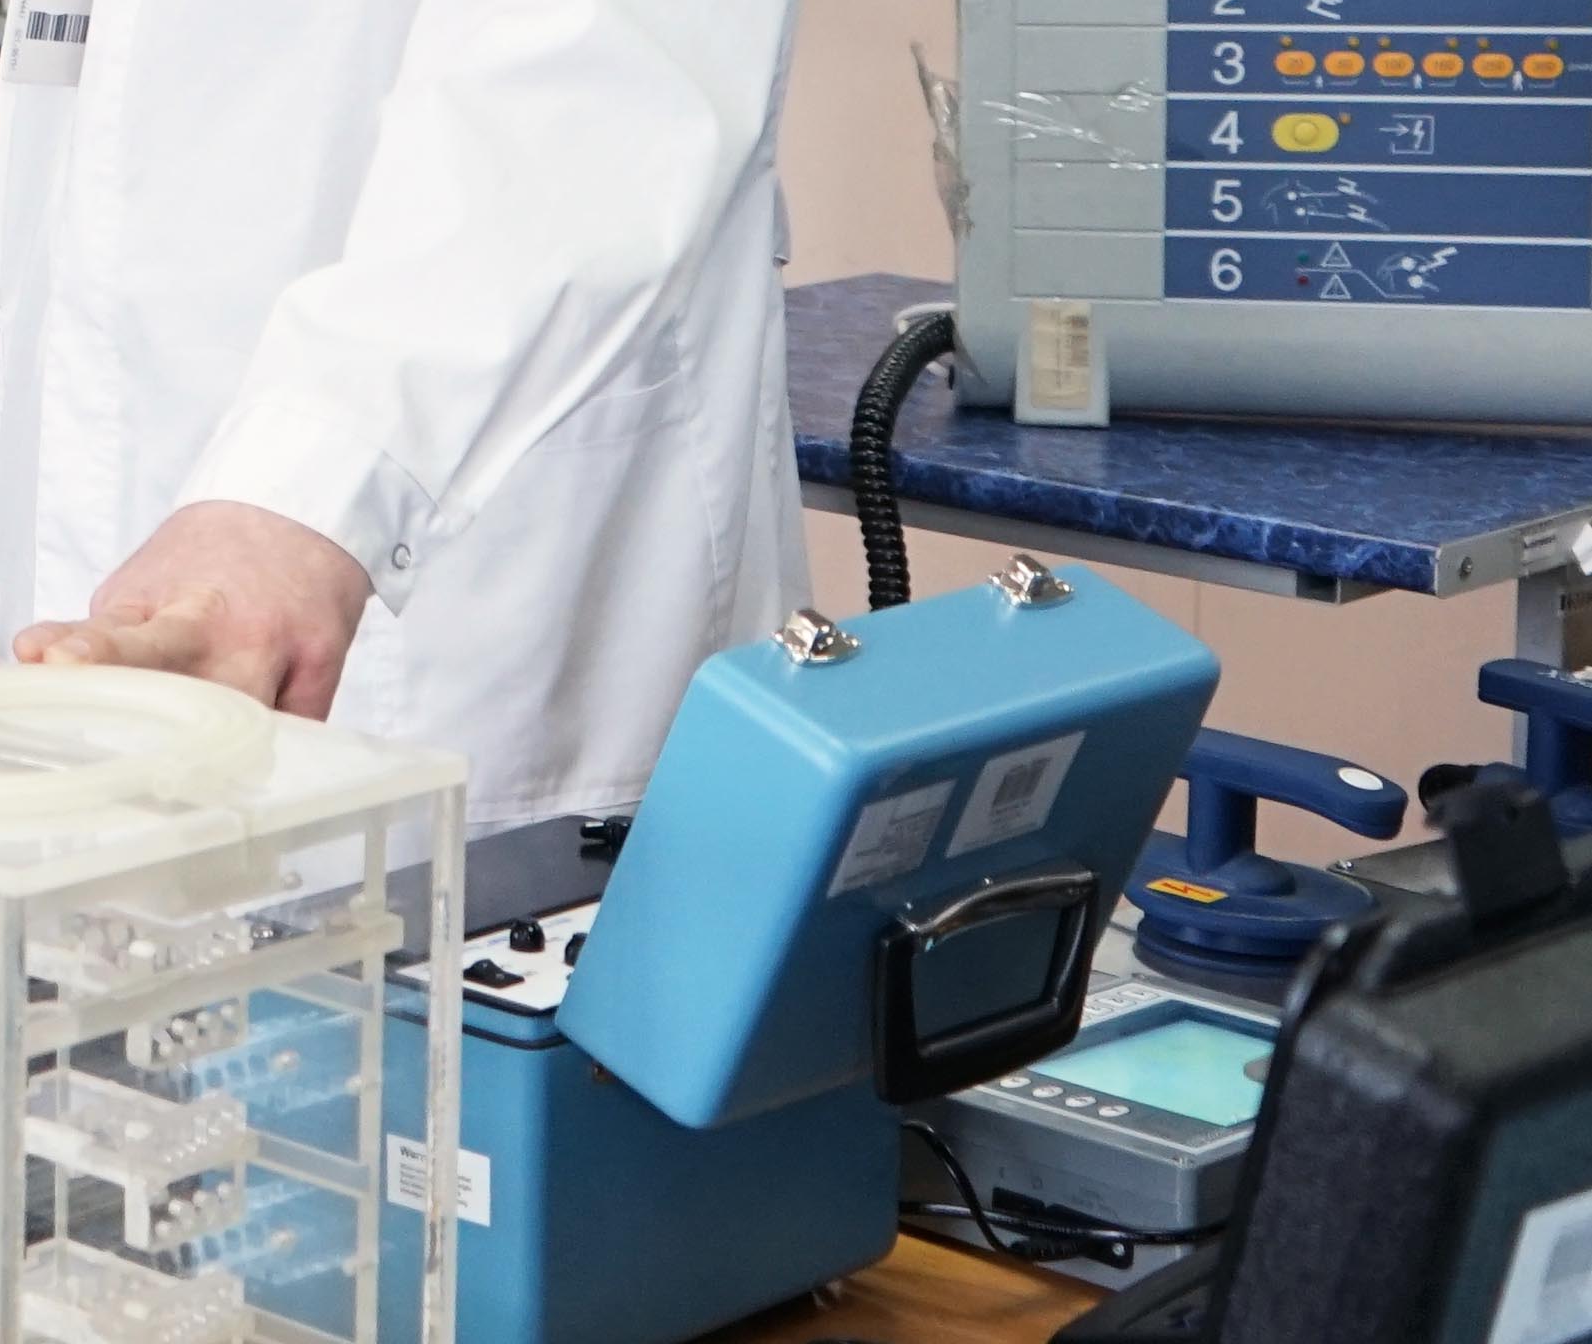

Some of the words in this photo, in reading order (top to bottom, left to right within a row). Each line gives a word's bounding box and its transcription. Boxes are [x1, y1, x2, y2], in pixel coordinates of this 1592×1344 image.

[1213, 41, 1246, 86] 3
[1210, 110, 1244, 154] 4
[1212, 179, 1243, 223] 5
[1211, 248, 1243, 292] 6
